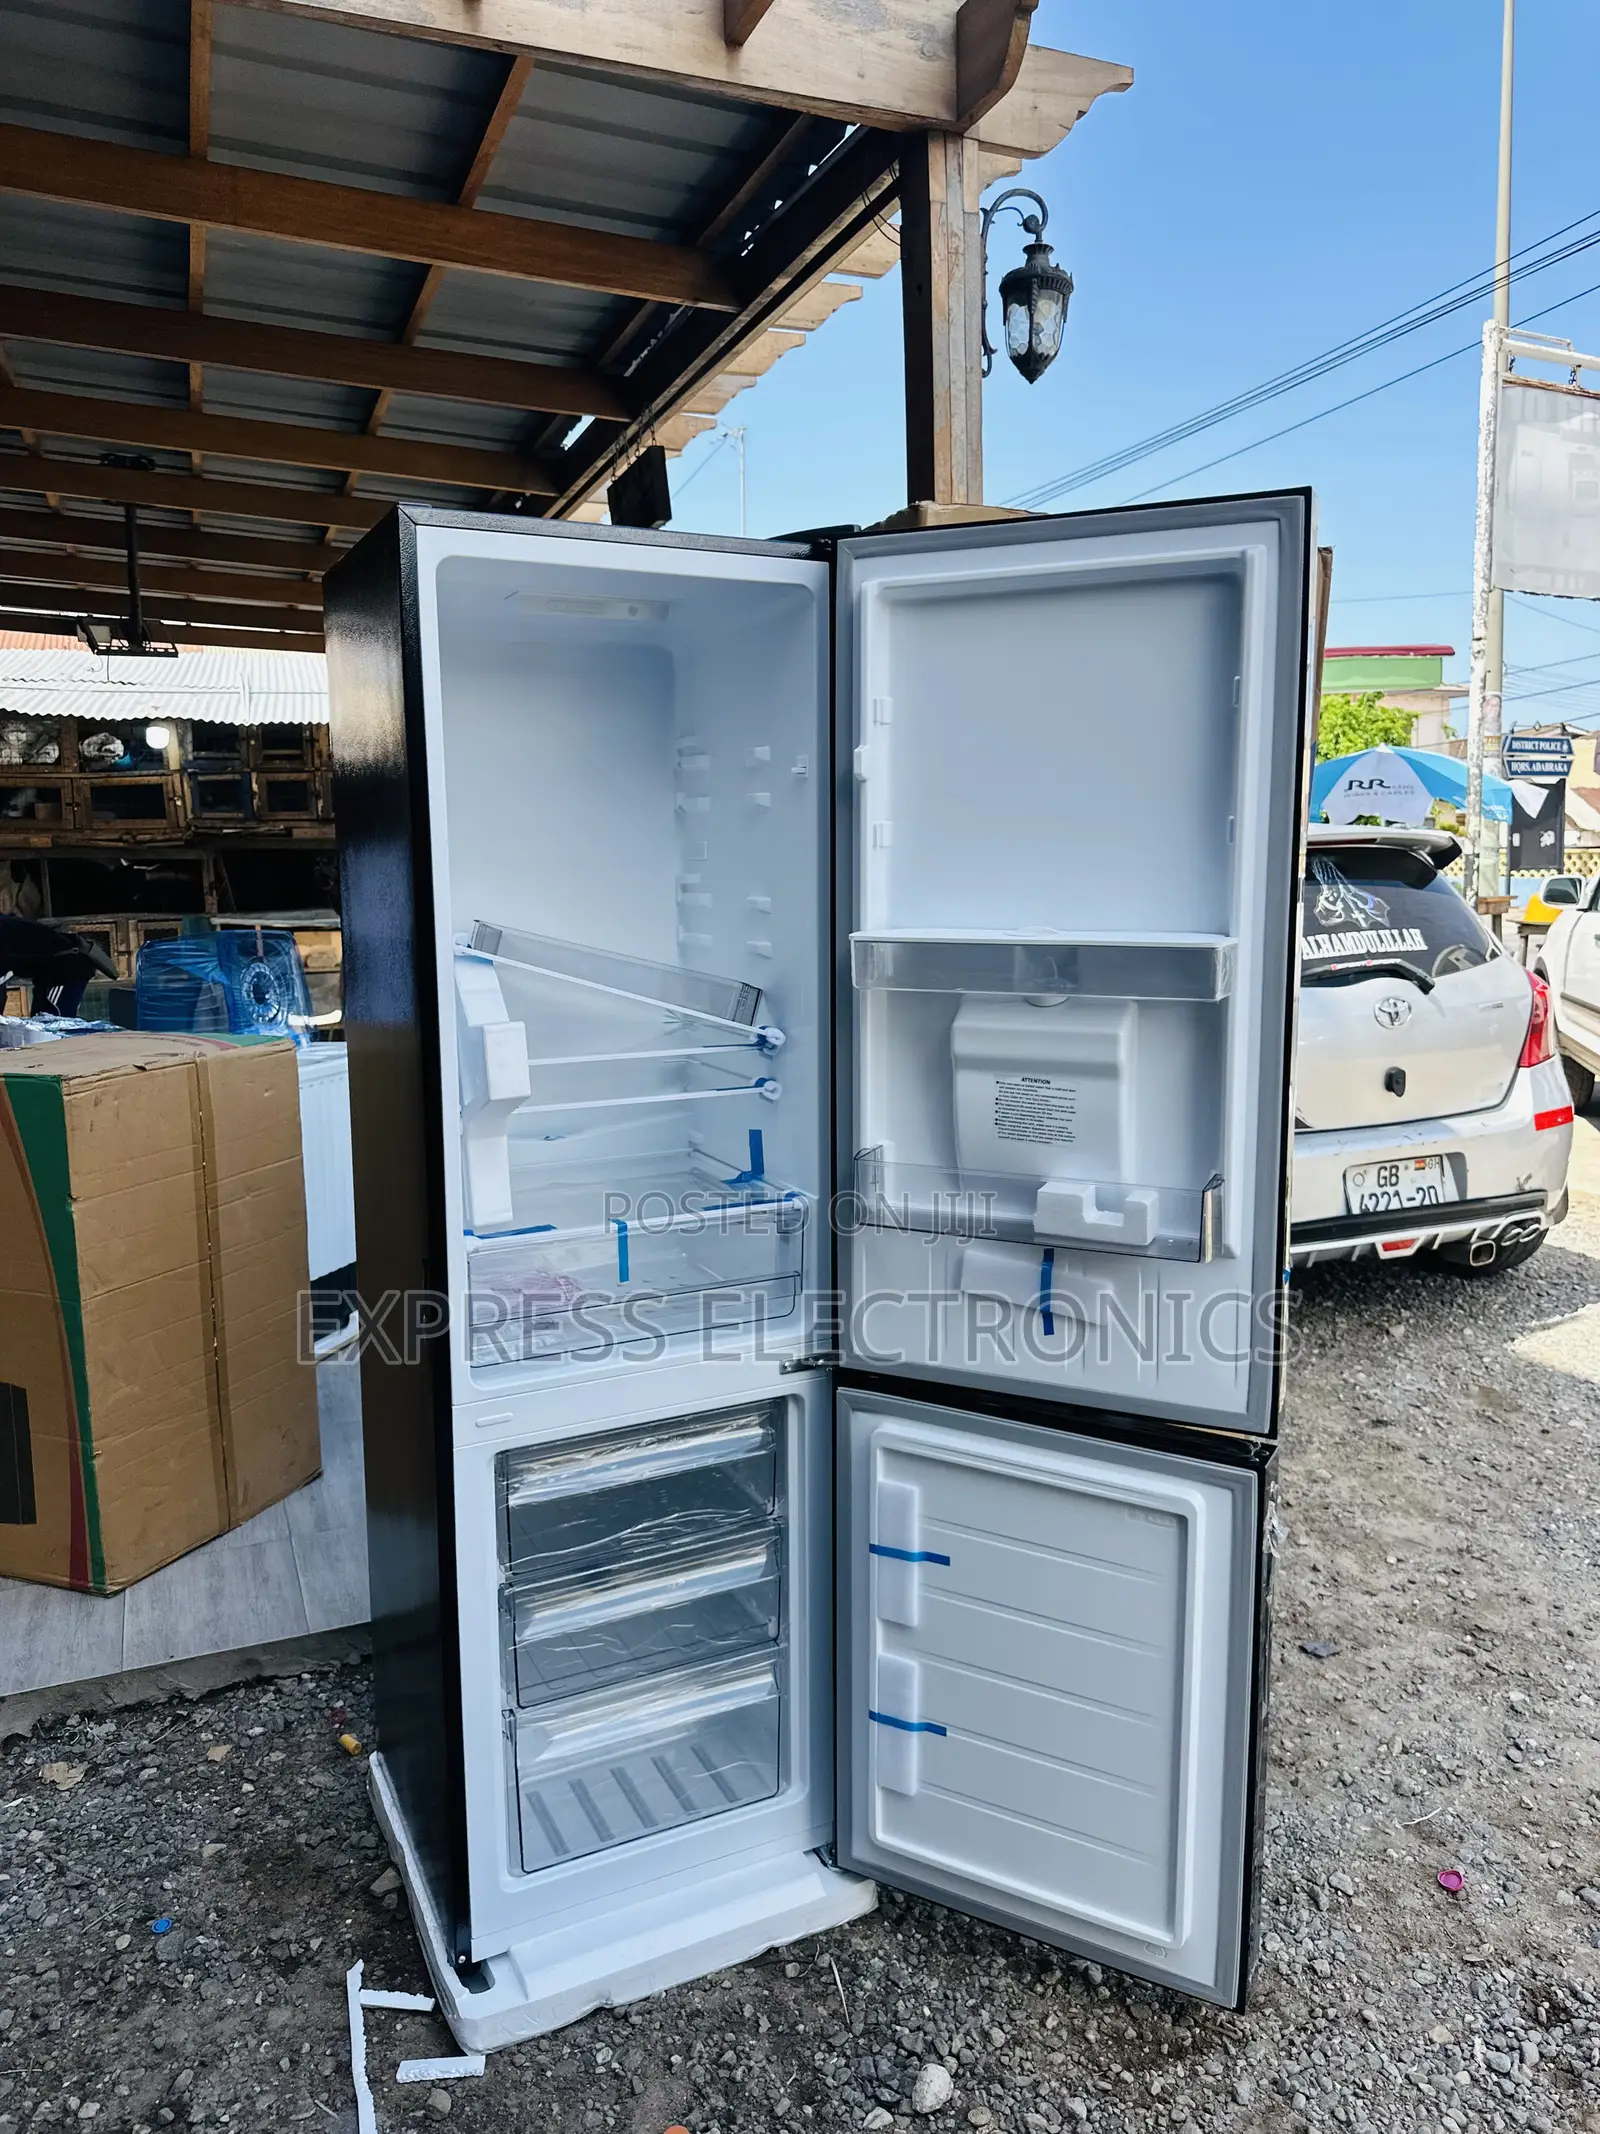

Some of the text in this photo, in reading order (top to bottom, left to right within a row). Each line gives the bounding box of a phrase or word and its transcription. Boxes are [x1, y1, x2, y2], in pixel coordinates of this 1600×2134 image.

[1512, 740, 1539, 750] DISTRICT
[1539, 741, 1561, 751] POLICE
[1021, 1077, 1051, 1085] ATTENTION
[1377, 1164, 1400, 1188] GB
